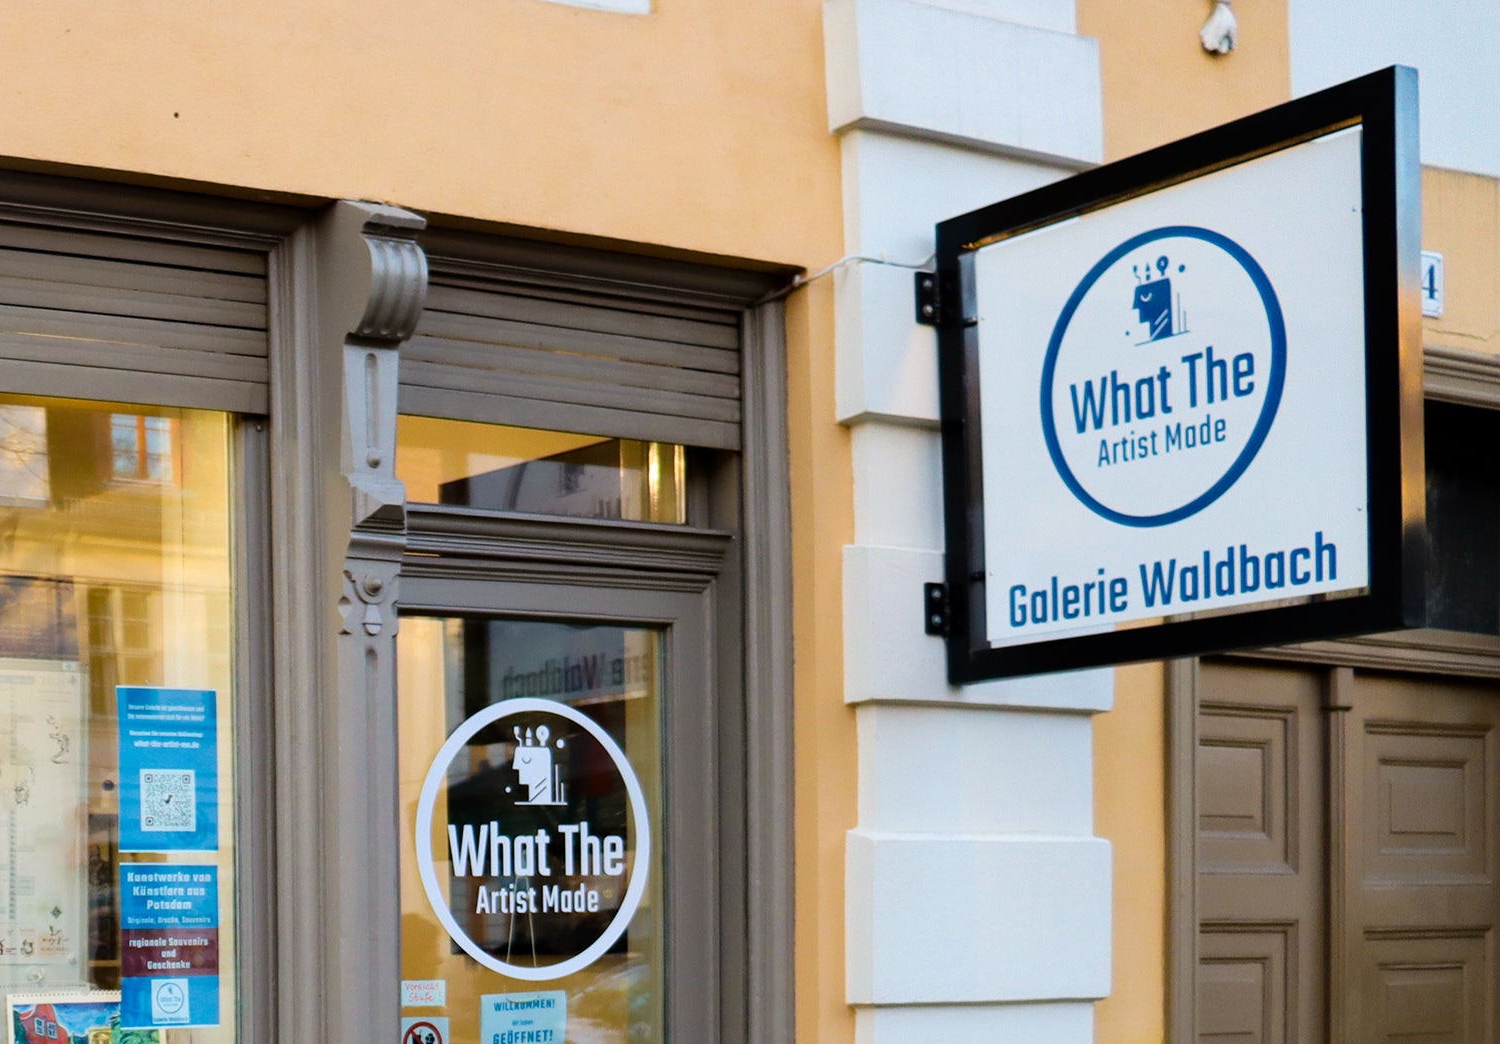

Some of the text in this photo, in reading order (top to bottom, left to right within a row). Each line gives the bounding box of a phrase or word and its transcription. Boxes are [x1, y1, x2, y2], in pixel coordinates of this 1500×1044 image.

[1070, 346, 1255, 434] What The
[1097, 414, 1227, 468] Artist Made
[1009, 531, 1337, 628] Galerie Waldbach
[447, 821, 625, 877] What The
[127, 872, 212, 882] Kunstwerke von
[132, 886, 206, 896] Künstlern aus
[147, 899, 192, 910] Potsdam
[476, 883, 599, 914] Artist Made
[129, 937, 209, 948] regionale Souvenirs
[161, 949, 177, 957] und
[147, 960, 191, 970] Geschenke
[494, 999, 555, 1012] WILLKOMMEN!
